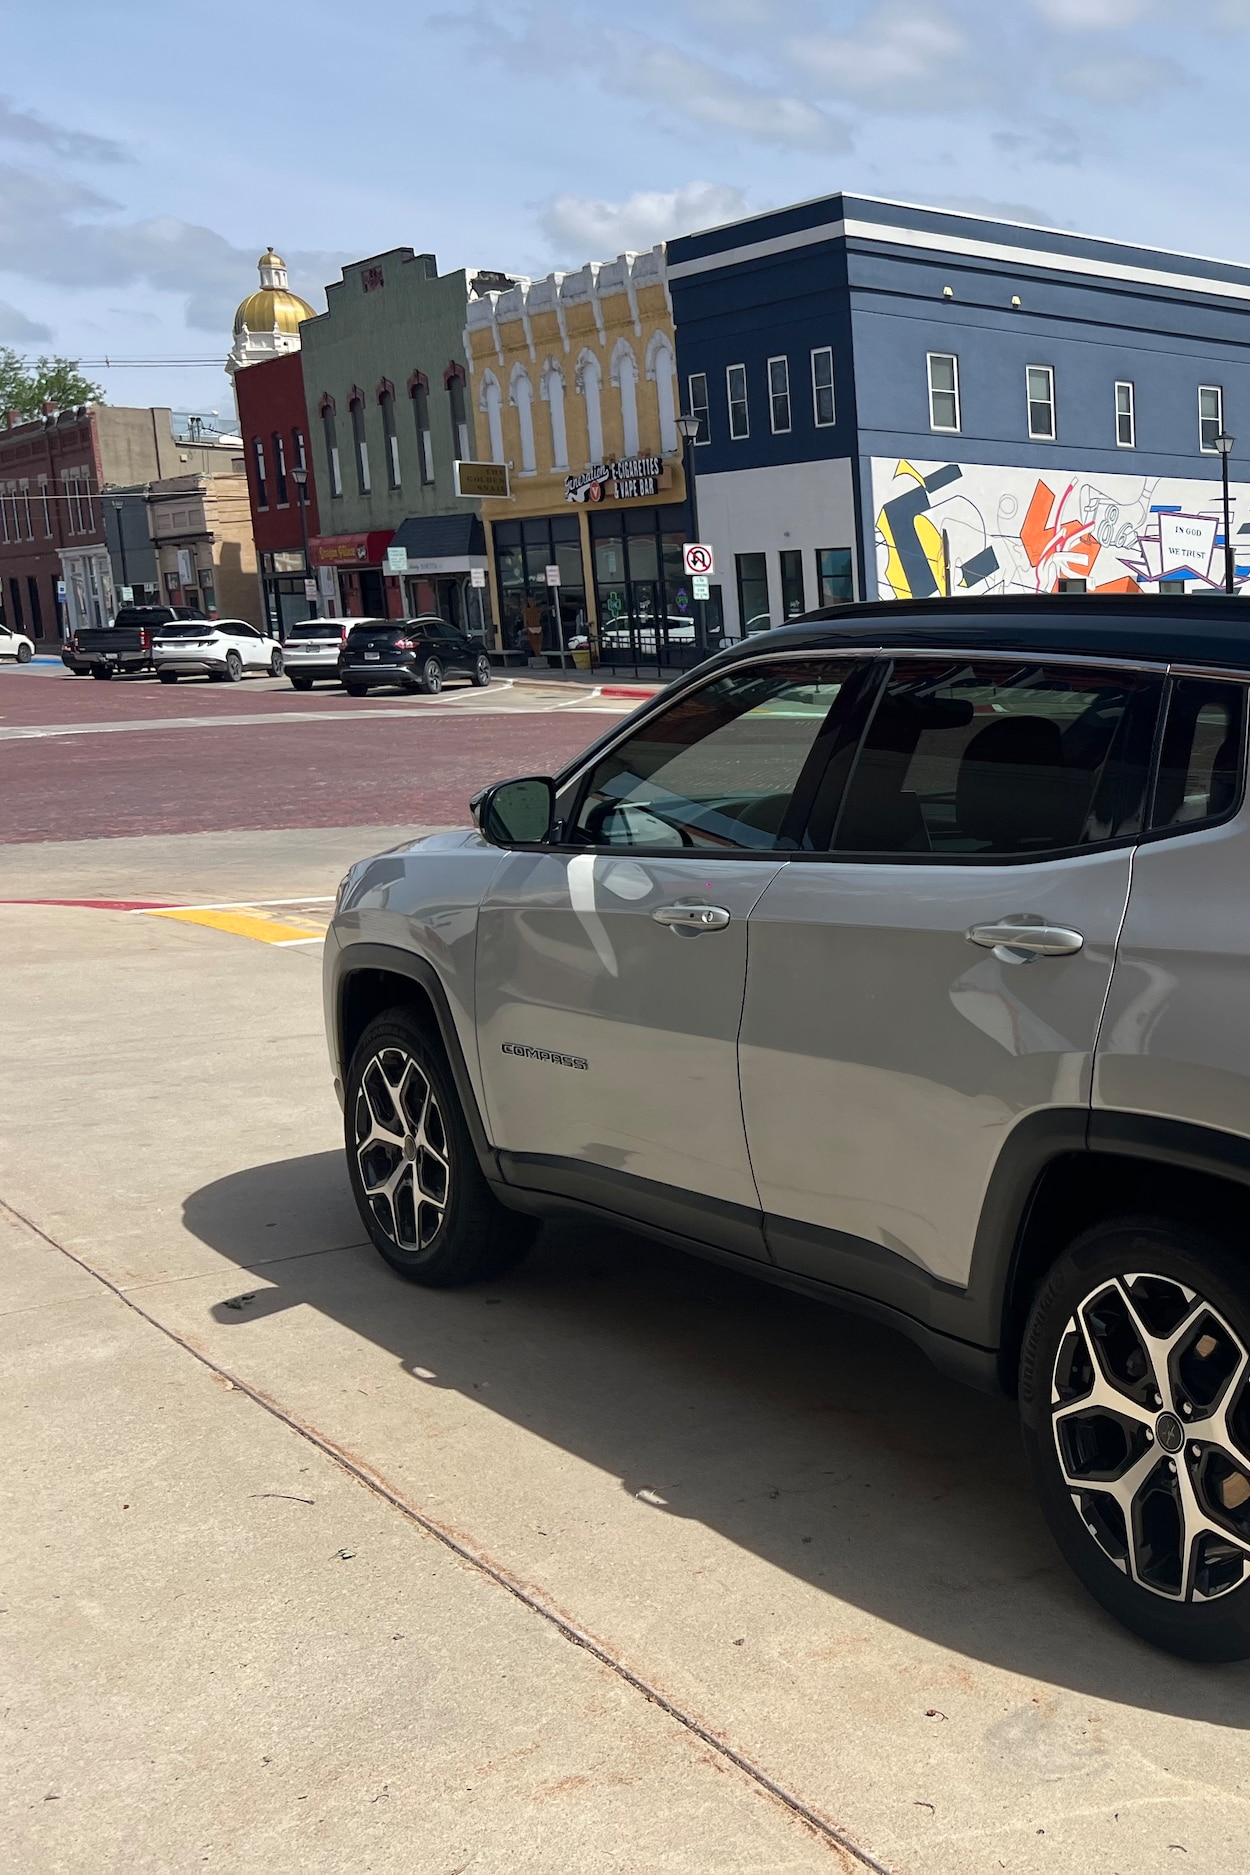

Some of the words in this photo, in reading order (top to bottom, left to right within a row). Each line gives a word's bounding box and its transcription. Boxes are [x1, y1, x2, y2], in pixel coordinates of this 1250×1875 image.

[611, 458, 660, 480] E-CIGARETTES
[614, 482, 620, 499] &
[620, 479, 638, 498] VAPE
[640, 477, 655, 496] BAR
[1175, 526, 1184, 534] IN
[1185, 528, 1202, 536] GOD
[1169, 547, 1181, 555] WE
[1181, 549, 1206, 559] TRUST
[501, 1042, 588, 1070] COMPASS
